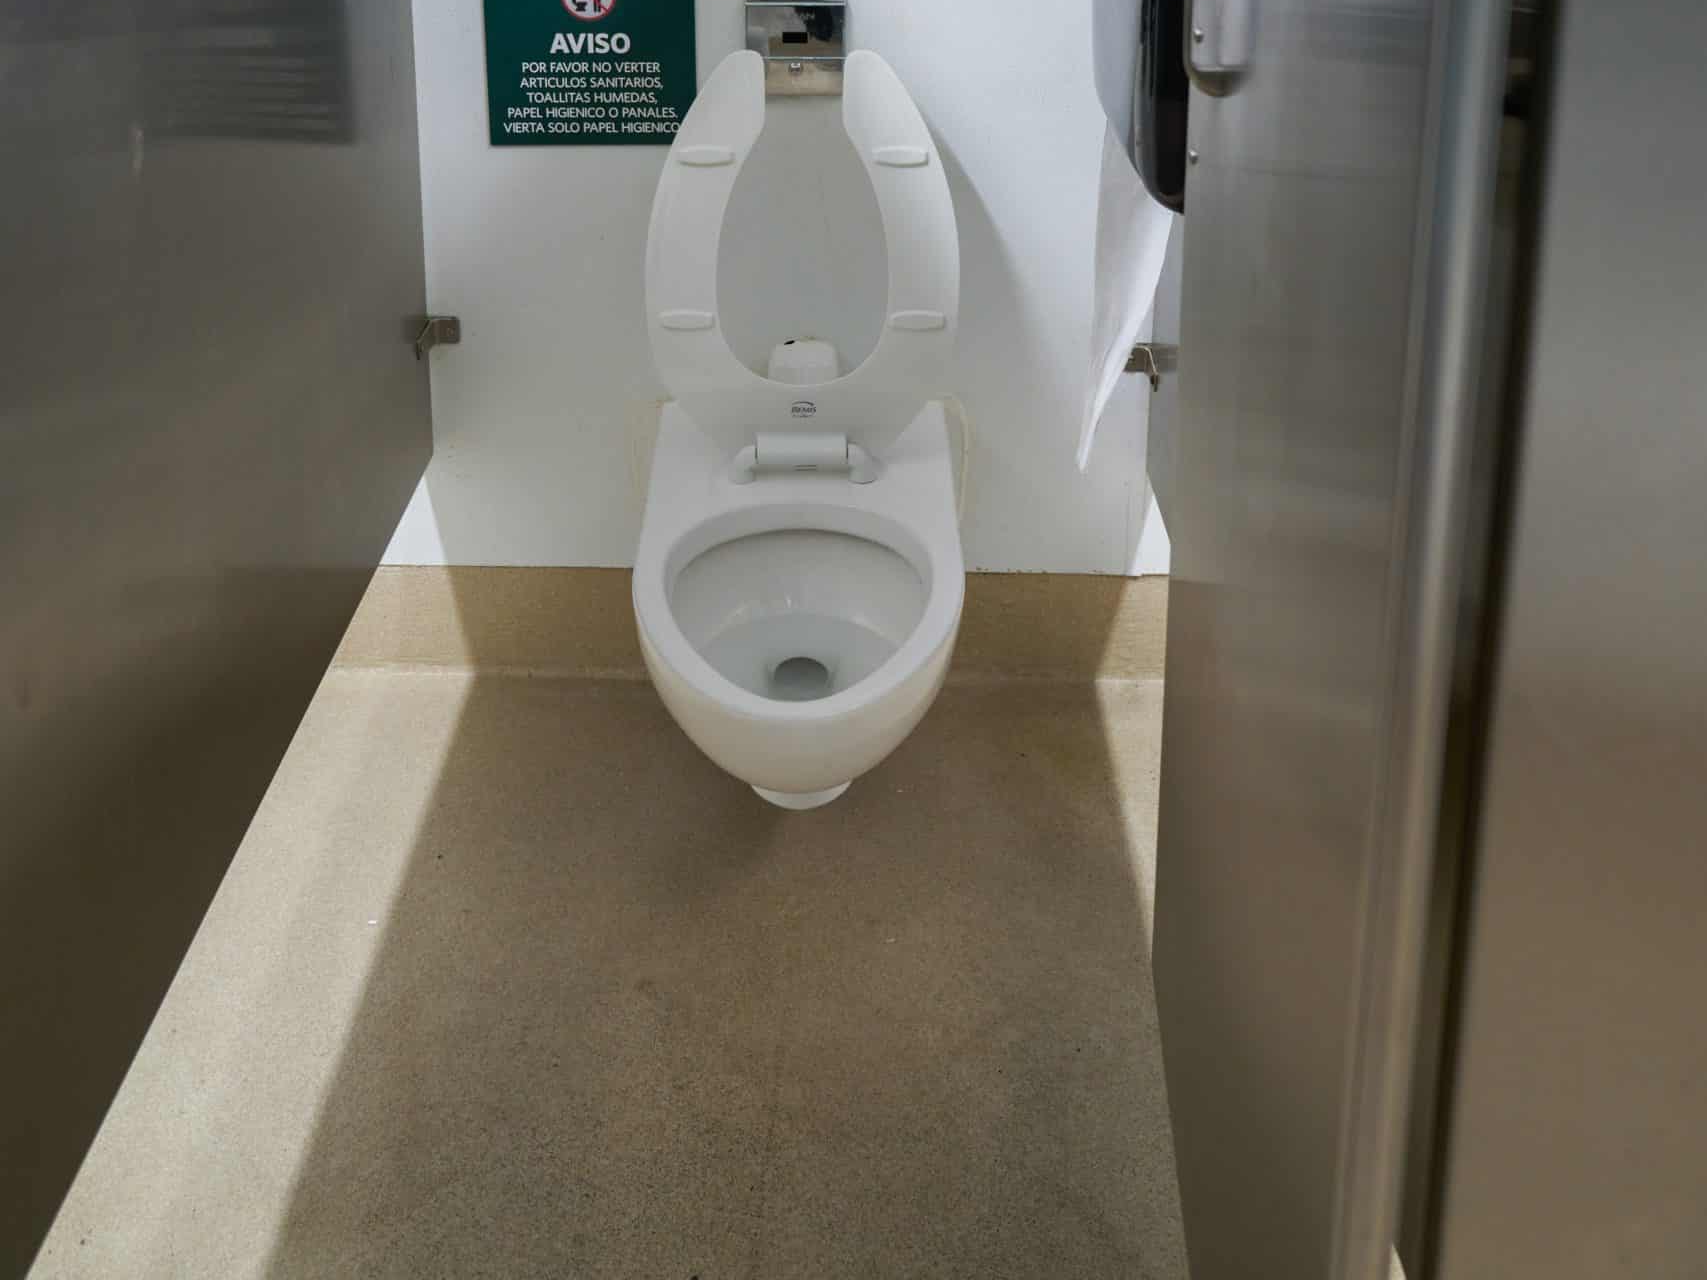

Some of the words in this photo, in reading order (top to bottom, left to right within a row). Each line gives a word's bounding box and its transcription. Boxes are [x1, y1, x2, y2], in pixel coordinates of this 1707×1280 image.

[549, 33, 631, 54] AVISO
[521, 62, 547, 73] POR
[550, 62, 590, 73] FAVOR
[592, 62, 612, 73] NO
[614, 62, 661, 73] VERTER
[520, 77, 587, 89] ARTICULOS
[589, 77, 664, 90] SANITARIOS,
[526, 92, 591, 103] TOALLITAS
[593, 92, 658, 105] HUMEDAS,
[507, 107, 543, 119] PAPEL
[545, 107, 606, 119] HIGIENICO
[608, 107, 619, 119] O
[503, 122, 545, 133] VIERTA
[547, 122, 580, 133] SOLO
[583, 122, 619, 133] PAPEL
[621, 122, 681, 133] HIGIENICO
